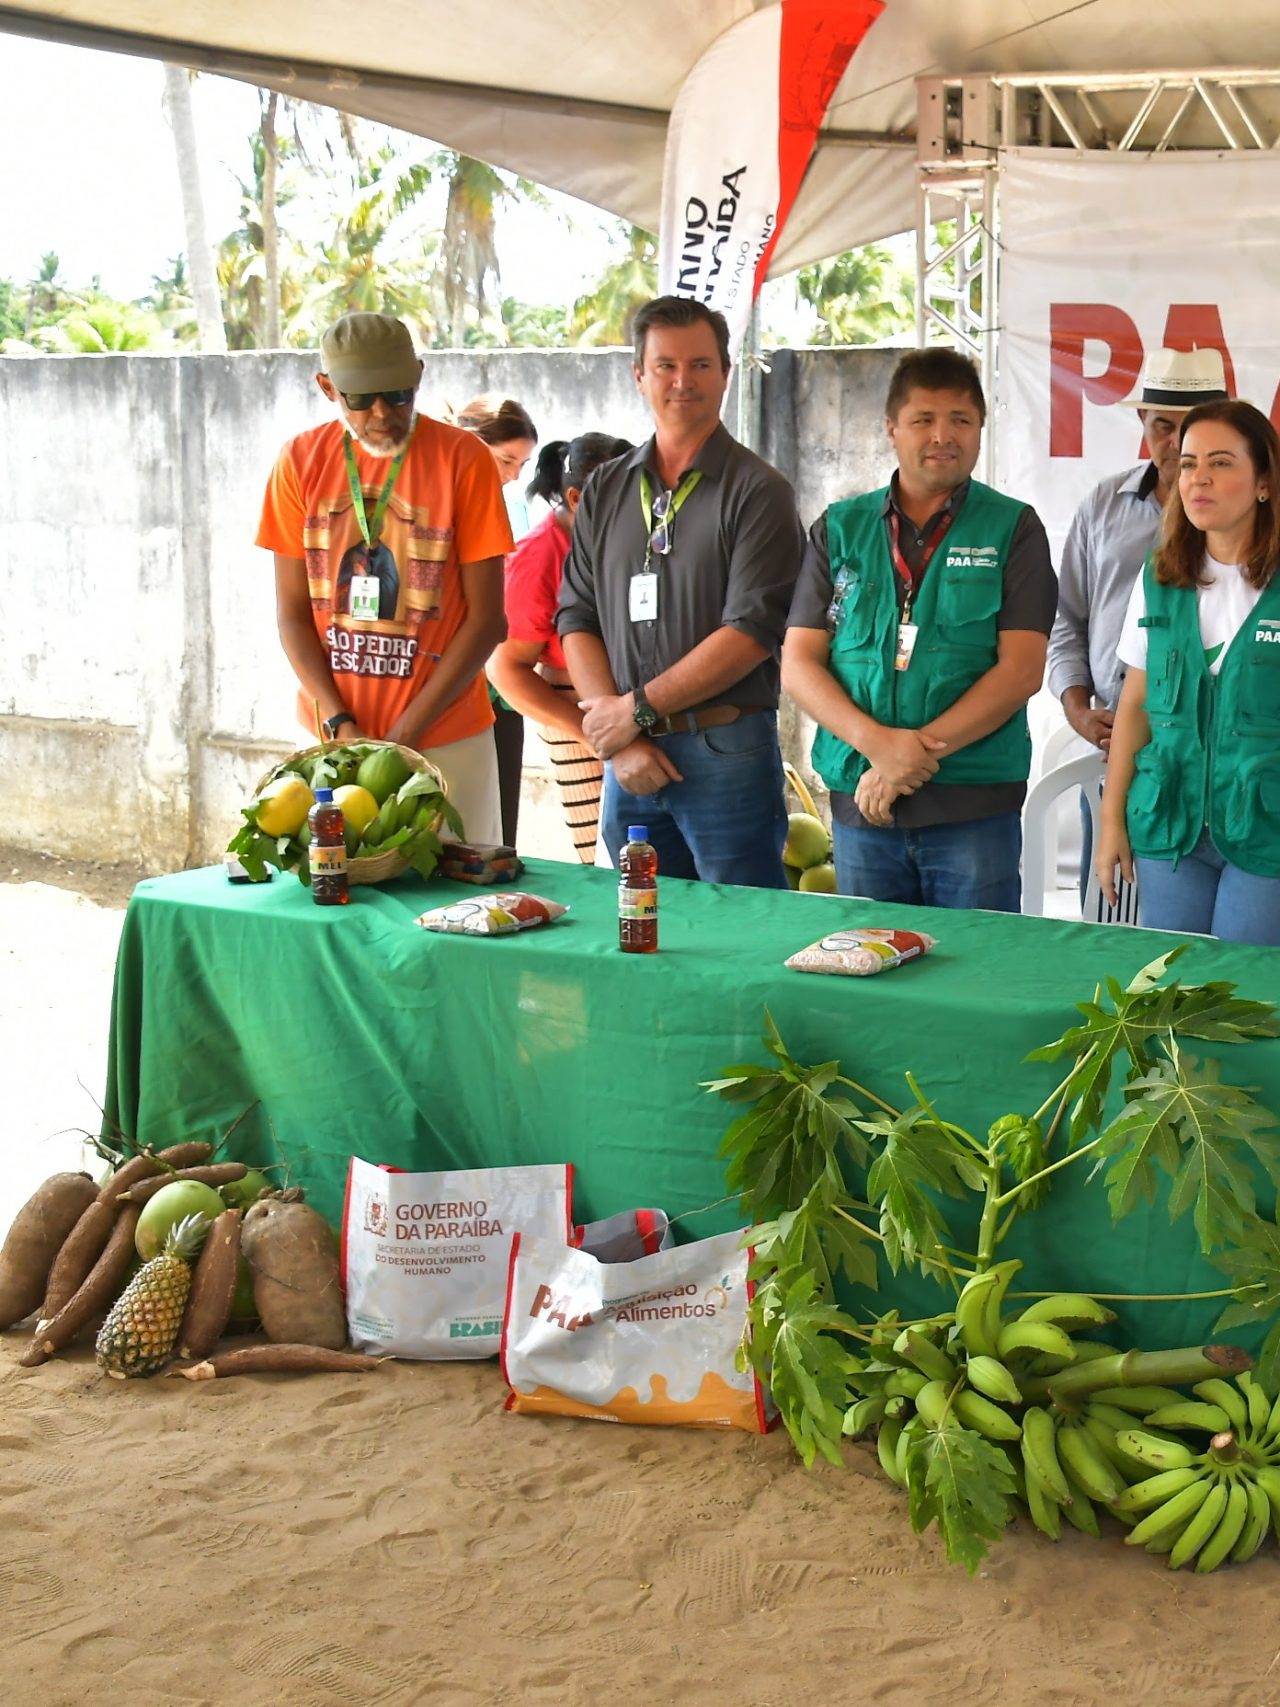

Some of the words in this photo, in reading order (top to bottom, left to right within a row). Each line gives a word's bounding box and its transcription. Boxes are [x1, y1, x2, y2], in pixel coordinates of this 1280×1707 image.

[946, 556, 971, 567] PAA
[353, 634, 417, 657] PEDRO
[331, 651, 411, 676] ESCADOR
[395, 1200, 487, 1220] GOVERNO
[395, 1223, 421, 1240] DA
[425, 1217, 503, 1239] PARAÍBA
[377, 1244, 426, 1255] SECRETARIA
[427, 1245, 441, 1255] DE
[443, 1244, 481, 1254] ESTADO
[375, 1254, 387, 1263] DO
[388, 1255, 486, 1265] DESENVOLVIMENTO
[404, 1266, 451, 1276] HUMANO
[616, 1302, 716, 1323] Alimentos
[450, 1321, 503, 1338] BRASI
